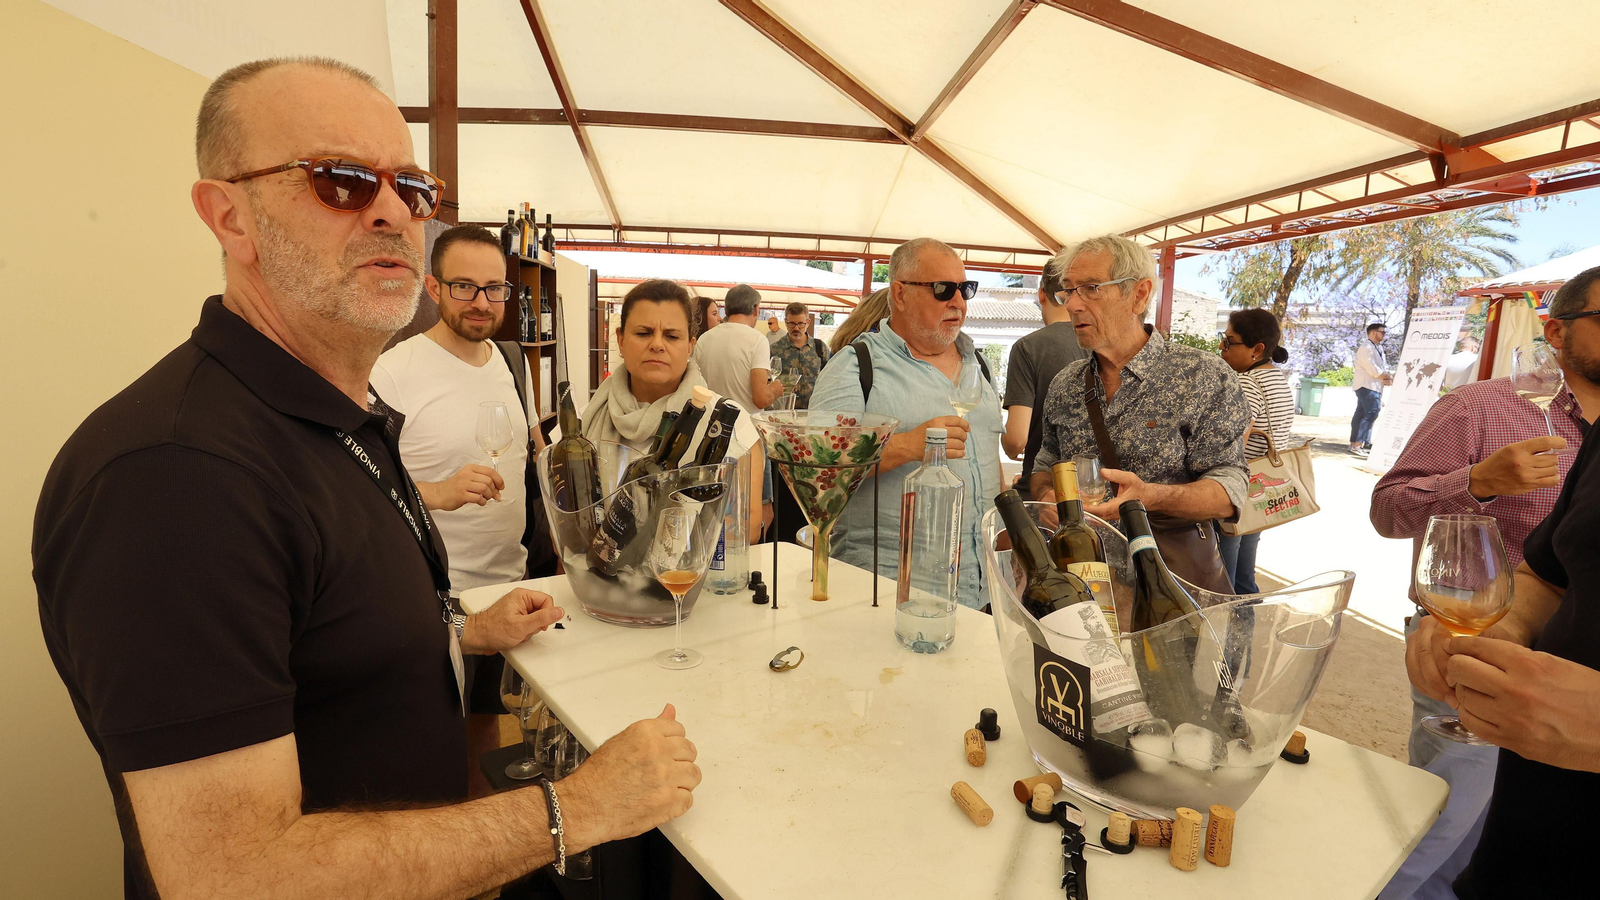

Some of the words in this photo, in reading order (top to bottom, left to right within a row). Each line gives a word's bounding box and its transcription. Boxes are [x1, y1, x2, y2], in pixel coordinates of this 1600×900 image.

[1421, 332, 1451, 340] MEDDIS
[1267, 495, 1287, 509] Star
[1288, 486, 1299, 498] of
[1264, 497, 1300, 516] ELECTRO
[1281, 506, 1302, 518] GIRL
[1102, 695, 1132, 709] CANTINE
